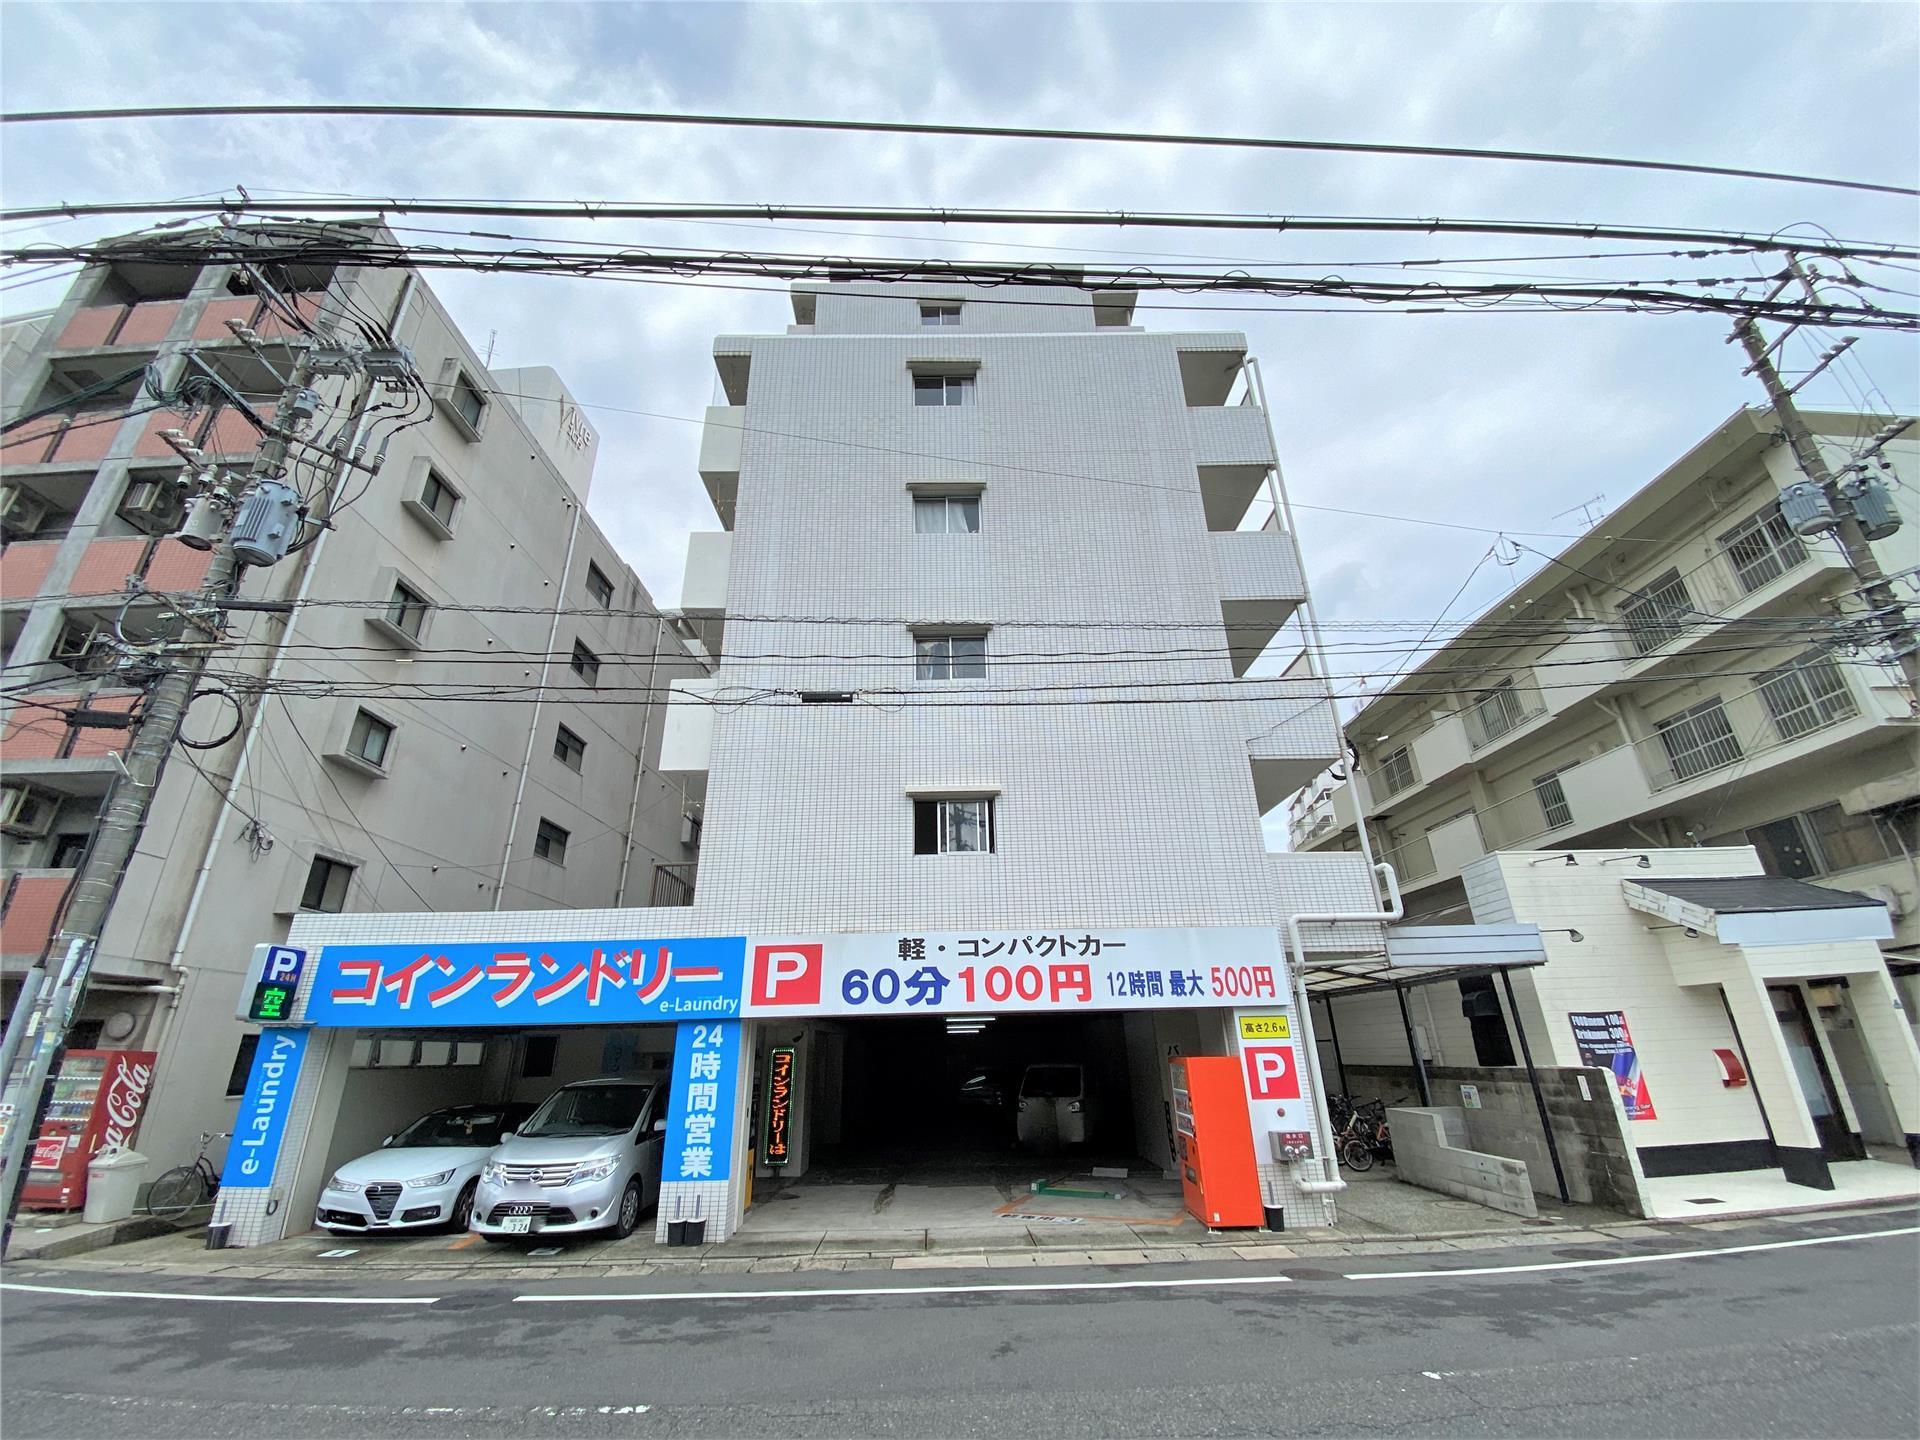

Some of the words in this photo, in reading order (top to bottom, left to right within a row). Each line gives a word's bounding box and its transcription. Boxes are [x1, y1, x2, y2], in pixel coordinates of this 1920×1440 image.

[270, 950, 297, 981] P
[330, 946, 723, 1008] コインランドリー
[765, 952, 808, 999] P
[1169, 969, 1204, 998] 最大
[1211, 965, 1276, 998] 500円
[260, 987, 287, 1017] 空
[659, 995, 739, 1014] e-Laundry
[1255, 1053, 1286, 1094] P
[241, 1035, 297, 1176] e-Laundry
[769, 1054, 791, 1155] コインランドリーは
